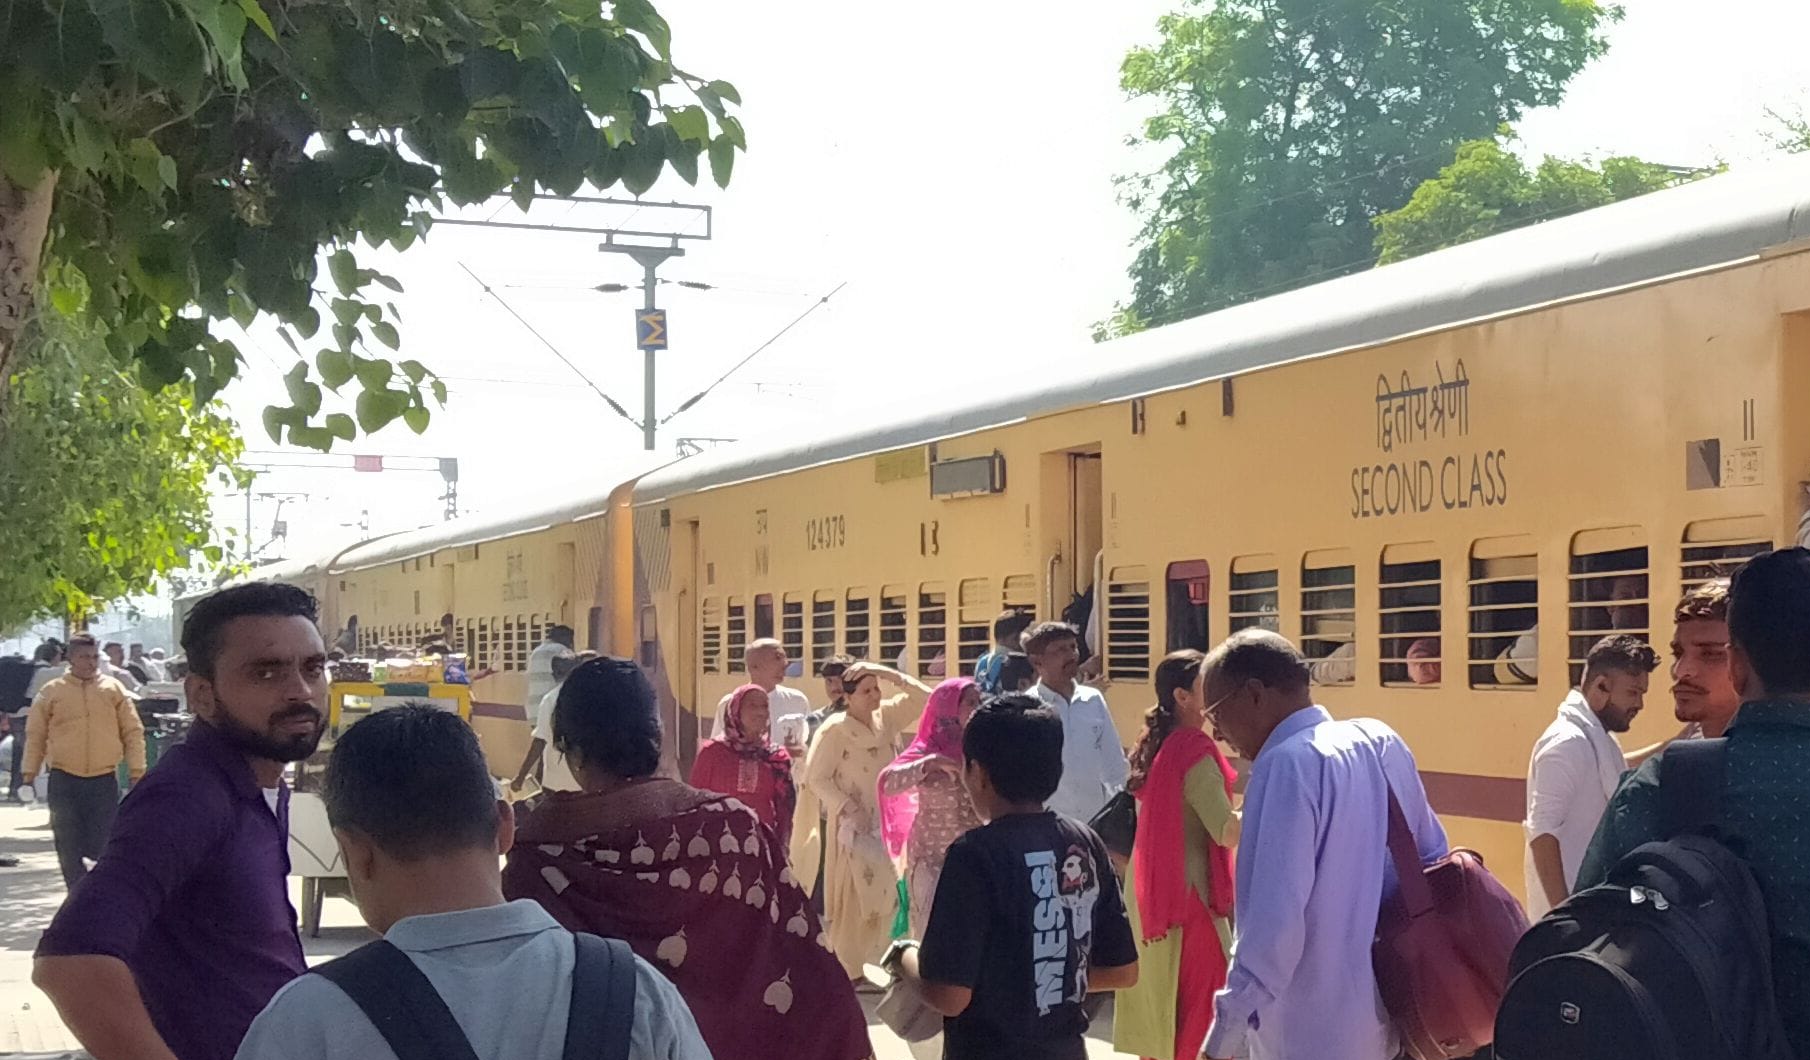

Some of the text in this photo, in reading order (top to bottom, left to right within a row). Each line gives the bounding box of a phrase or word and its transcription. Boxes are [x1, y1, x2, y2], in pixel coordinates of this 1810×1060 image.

[1351, 448, 1507, 519] SECOND CLASS
[805, 514, 845, 551] 124379
[1023, 850, 1068, 1017] MESSI
